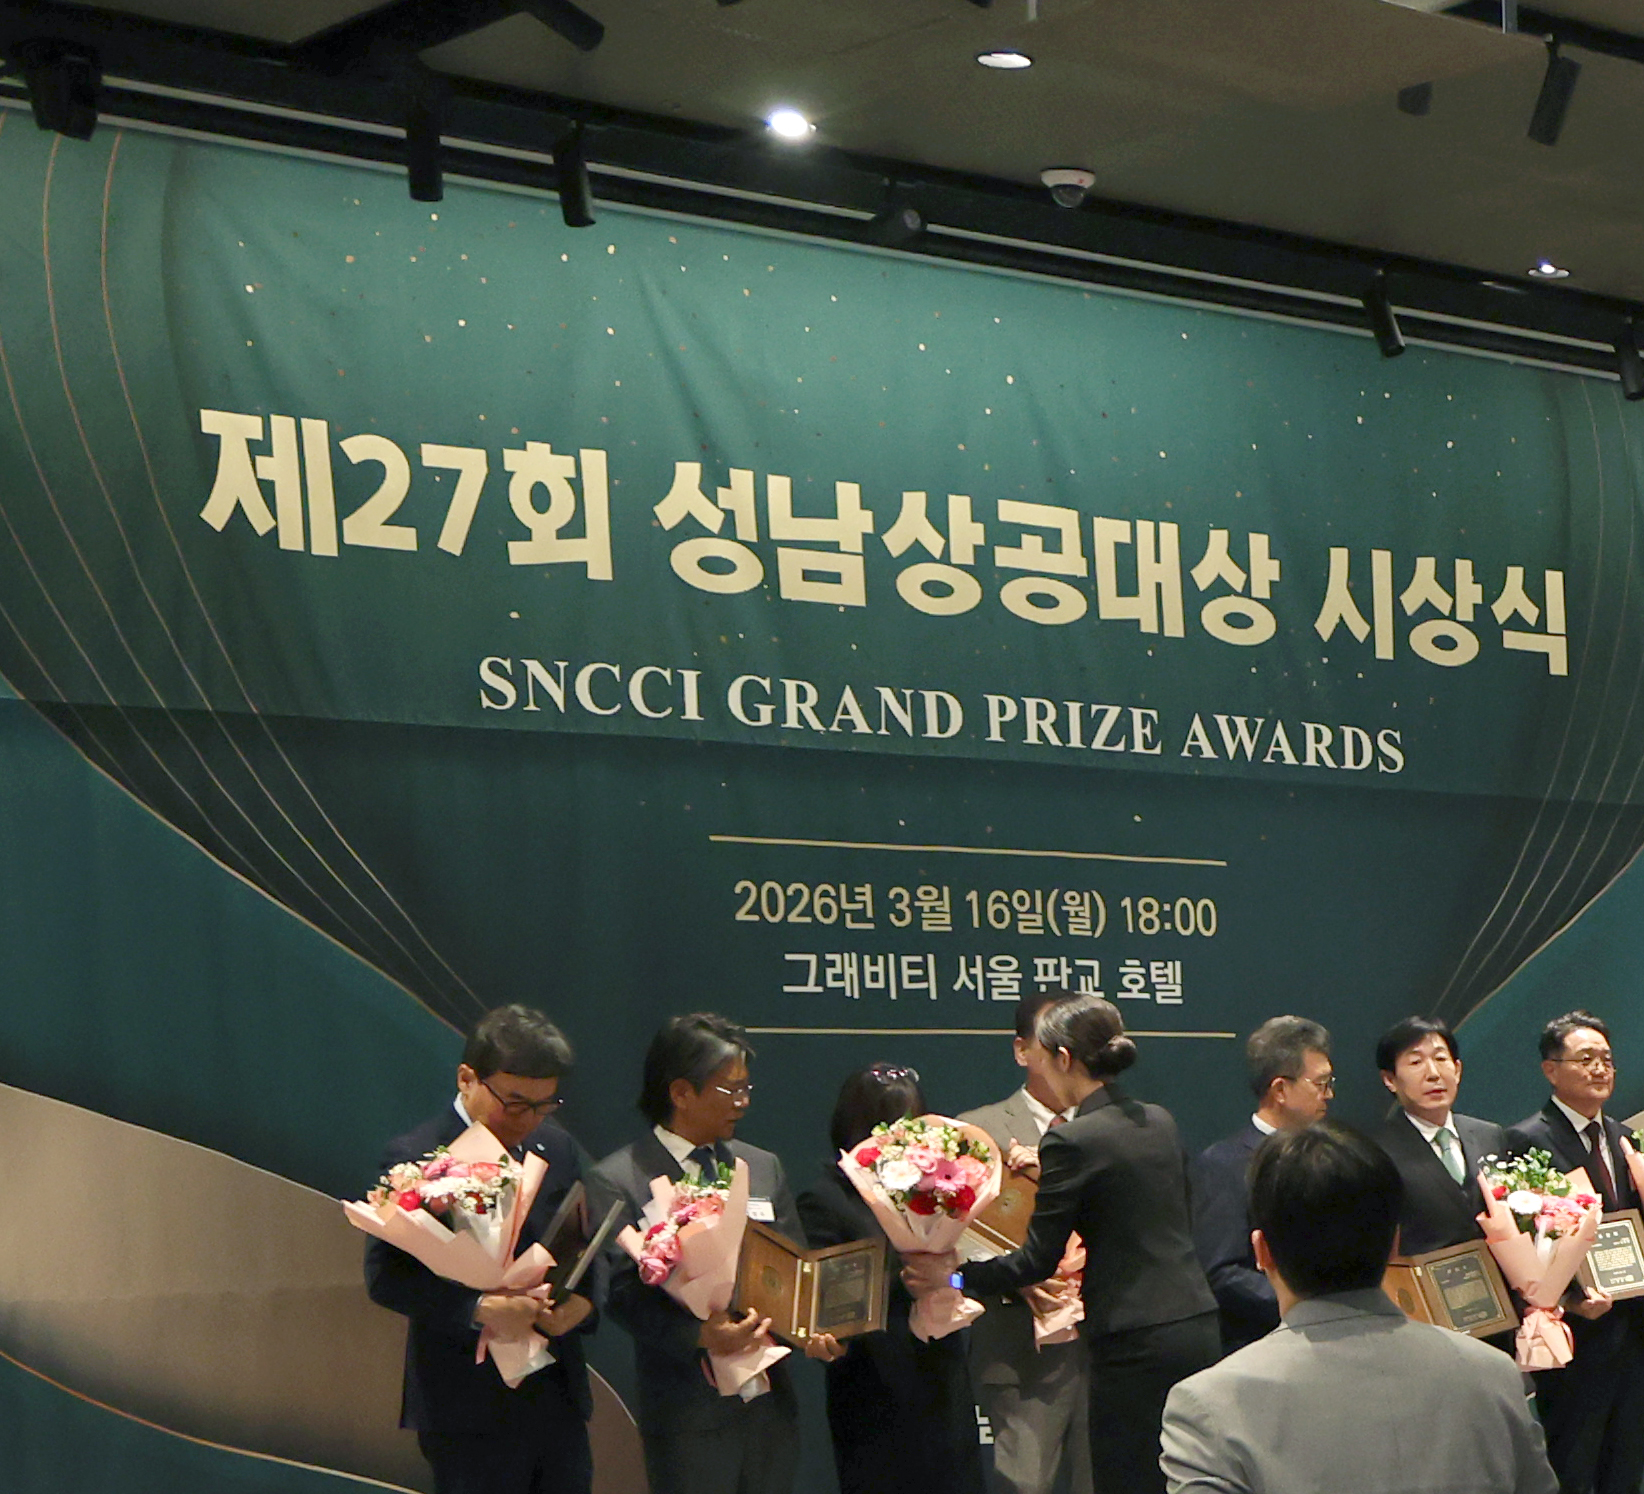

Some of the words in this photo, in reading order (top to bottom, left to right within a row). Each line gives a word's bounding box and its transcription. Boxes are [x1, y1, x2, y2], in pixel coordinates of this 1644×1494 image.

[201, 409, 612, 580] 제27회
[654, 460, 1279, 645] 성남상공대상
[1315, 548, 1567, 675] 시상식
[480, 657, 703, 720] SNCCI
[728, 676, 962, 737] GRAND
[984, 695, 1161, 754] PRIZE
[1181, 714, 1403, 772] AWARDS
[735, 881, 874, 929] 2026년
[889, 886, 952, 931] 3월
[966, 889, 1106, 937] 16일(월)
[1121, 897, 1216, 936] 18:00
[783, 953, 936, 1000] 그래비티
[954, 955, 1022, 1000] 서울
[1034, 957, 1104, 997] 판교
[1117, 960, 1182, 1004] 호텔
